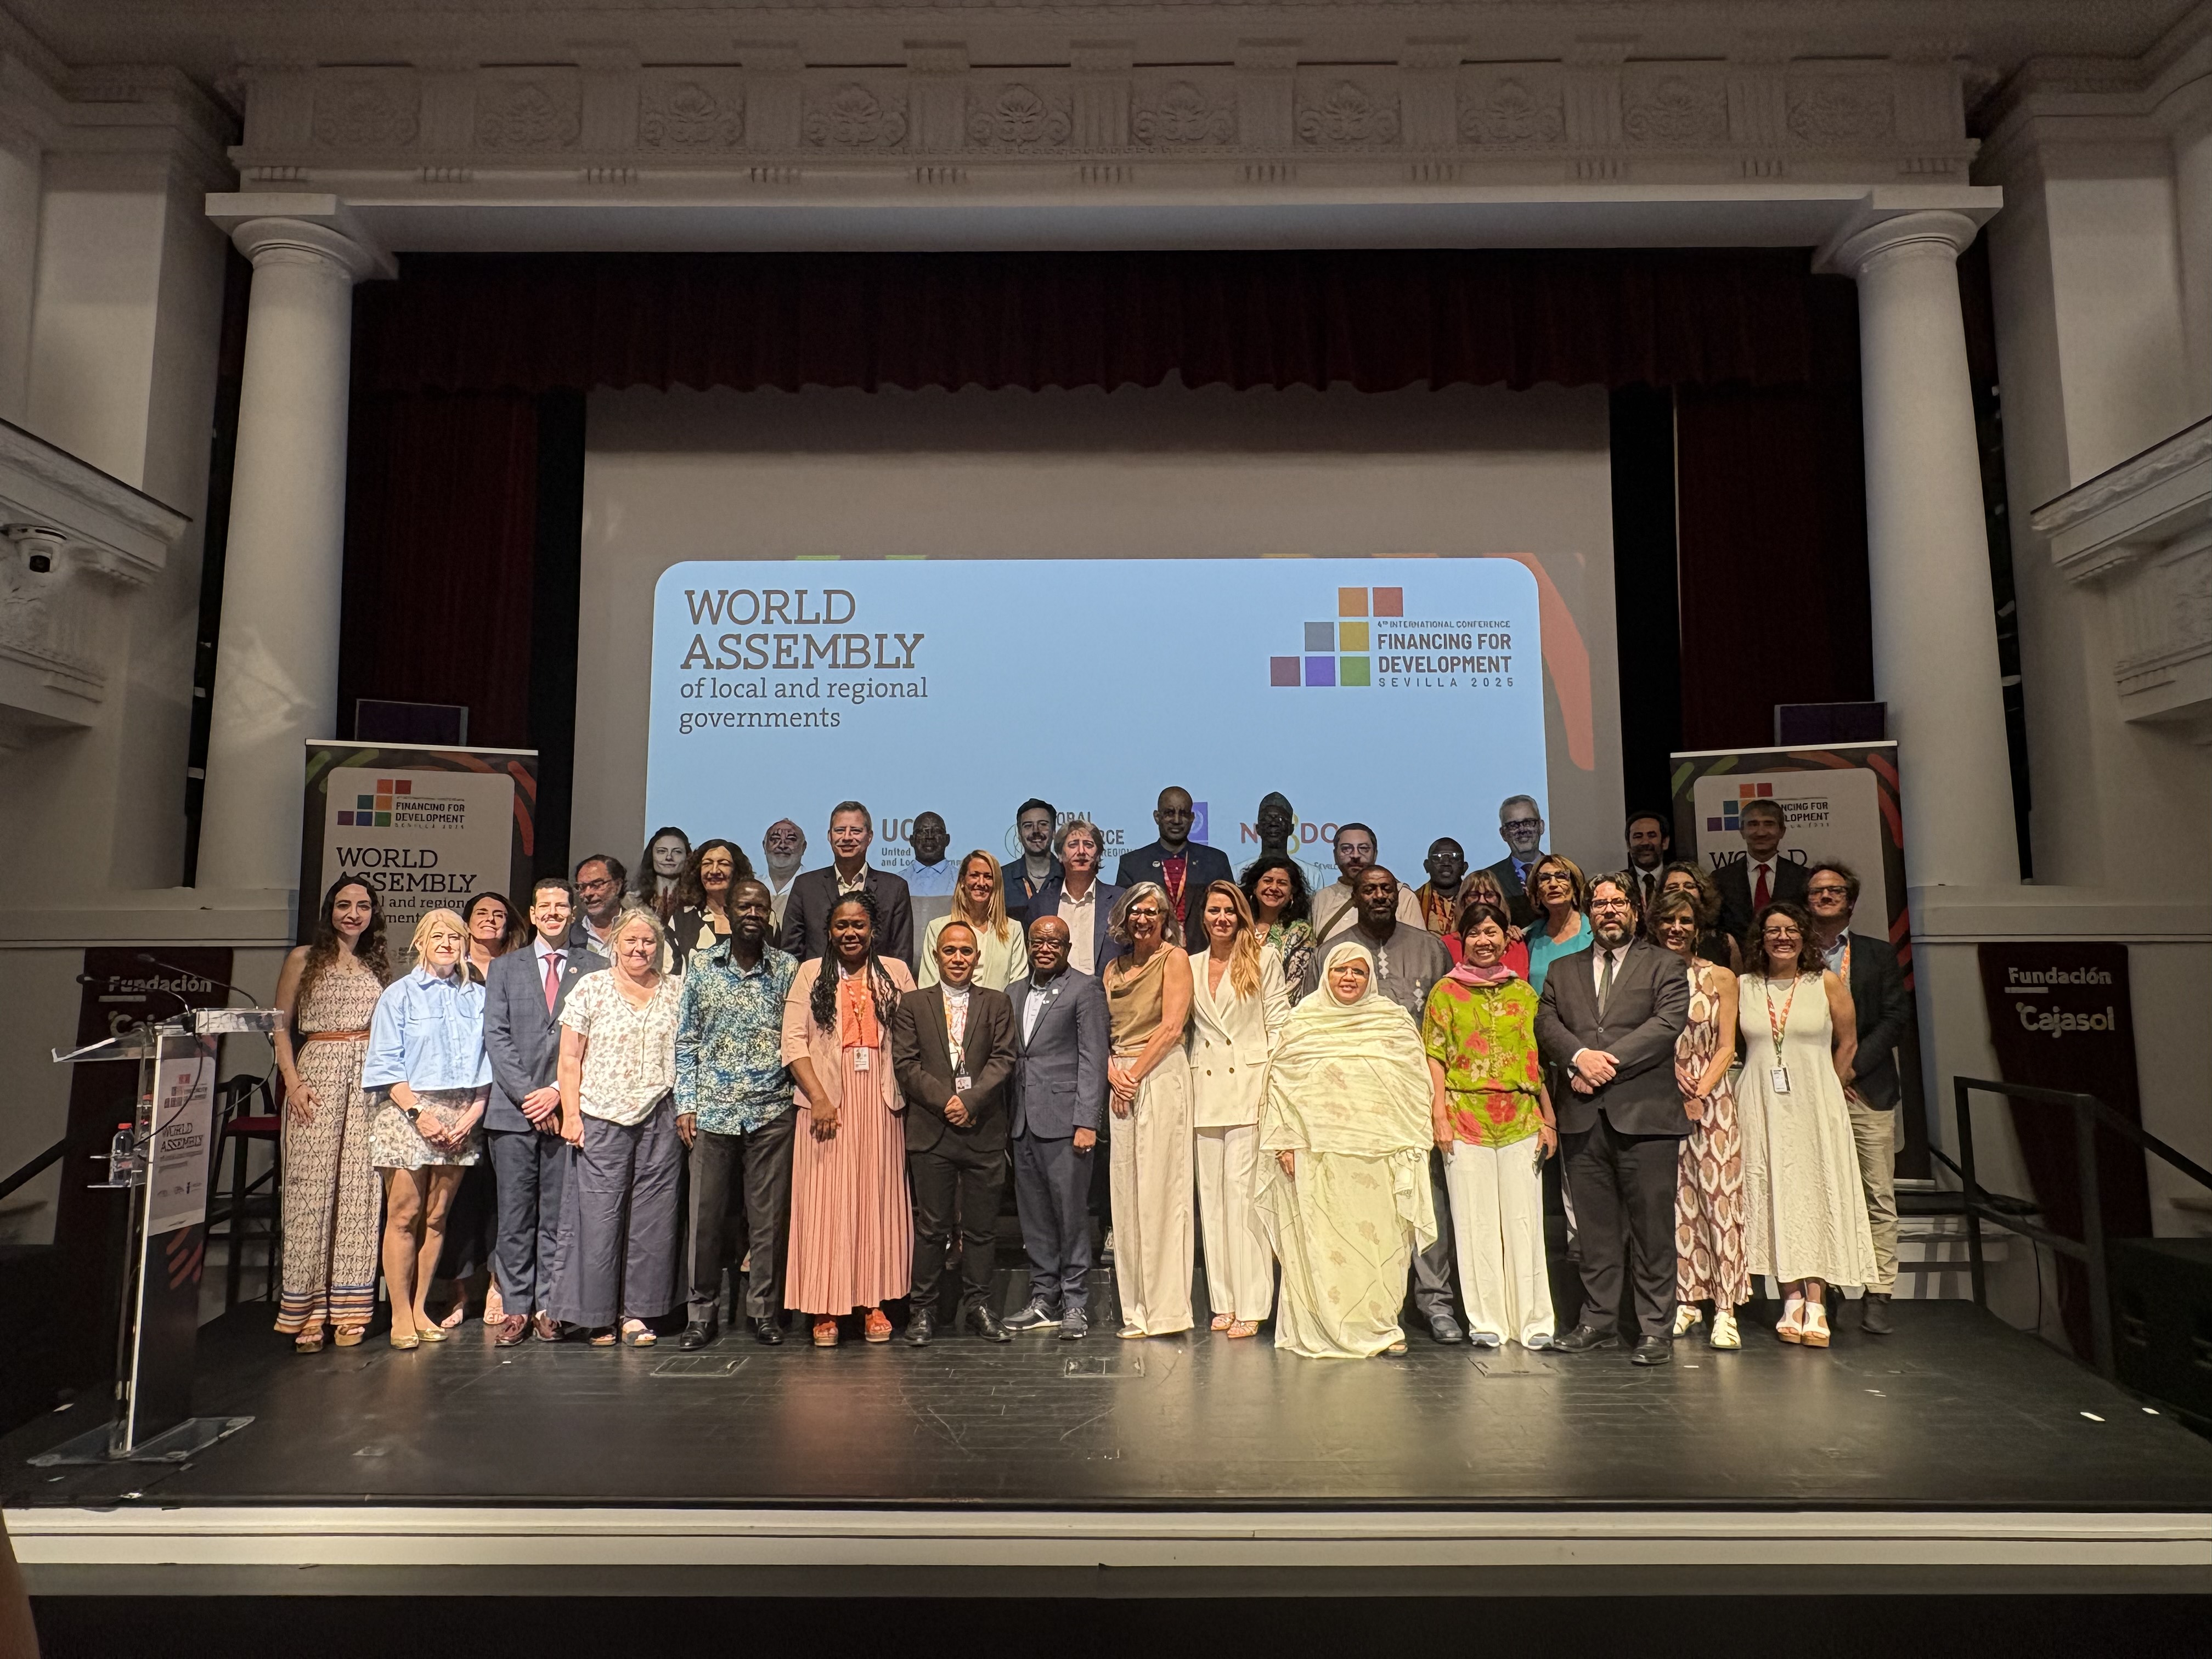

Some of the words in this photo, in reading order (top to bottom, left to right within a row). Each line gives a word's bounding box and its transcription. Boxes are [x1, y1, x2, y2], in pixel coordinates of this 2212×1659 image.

[685, 589, 855, 625] WORLD
[1378, 634, 1472, 650] FINANCING
[1477, 634, 1511, 650] FOR
[680, 633, 924, 670] ASSEMBLY
[1379, 656, 1512, 673] DEVELOPMENT
[680, 677, 706, 698] of
[710, 677, 768, 698] local
[775, 677, 820, 698] and
[827, 676, 928, 704] regional
[1379, 678, 1458, 687] SEVILLA
[1471, 678, 1513, 687] 2025
[679, 708, 840, 734] governments
[448, 804, 465, 812] FOR
[1811, 802, 1828, 810] FOR
[396, 812, 465, 823] DEVELOPMENT
[1784, 812, 1829, 822] LOPMENT
[336, 847, 438, 868] WORLD
[881, 858, 896, 866] and
[390, 896, 415, 908] and
[2008, 967, 2112, 985] Fundación
[2019, 1005, 2115, 1038] Cajasol
